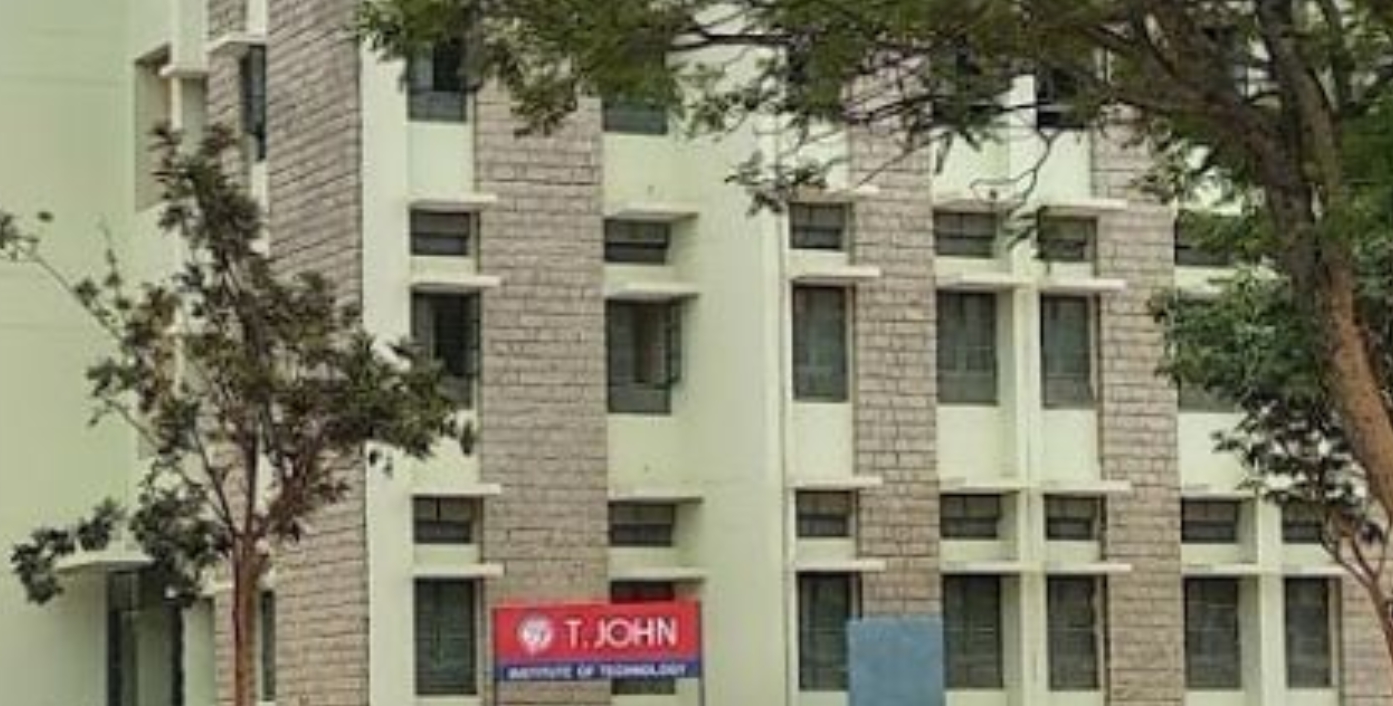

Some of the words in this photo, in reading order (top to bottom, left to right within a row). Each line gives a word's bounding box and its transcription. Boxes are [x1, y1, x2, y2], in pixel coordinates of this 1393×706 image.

[594, 616, 677, 649] JOHN
[577, 664, 595, 677] OF
[600, 663, 686, 676] TECHNOLOGY
